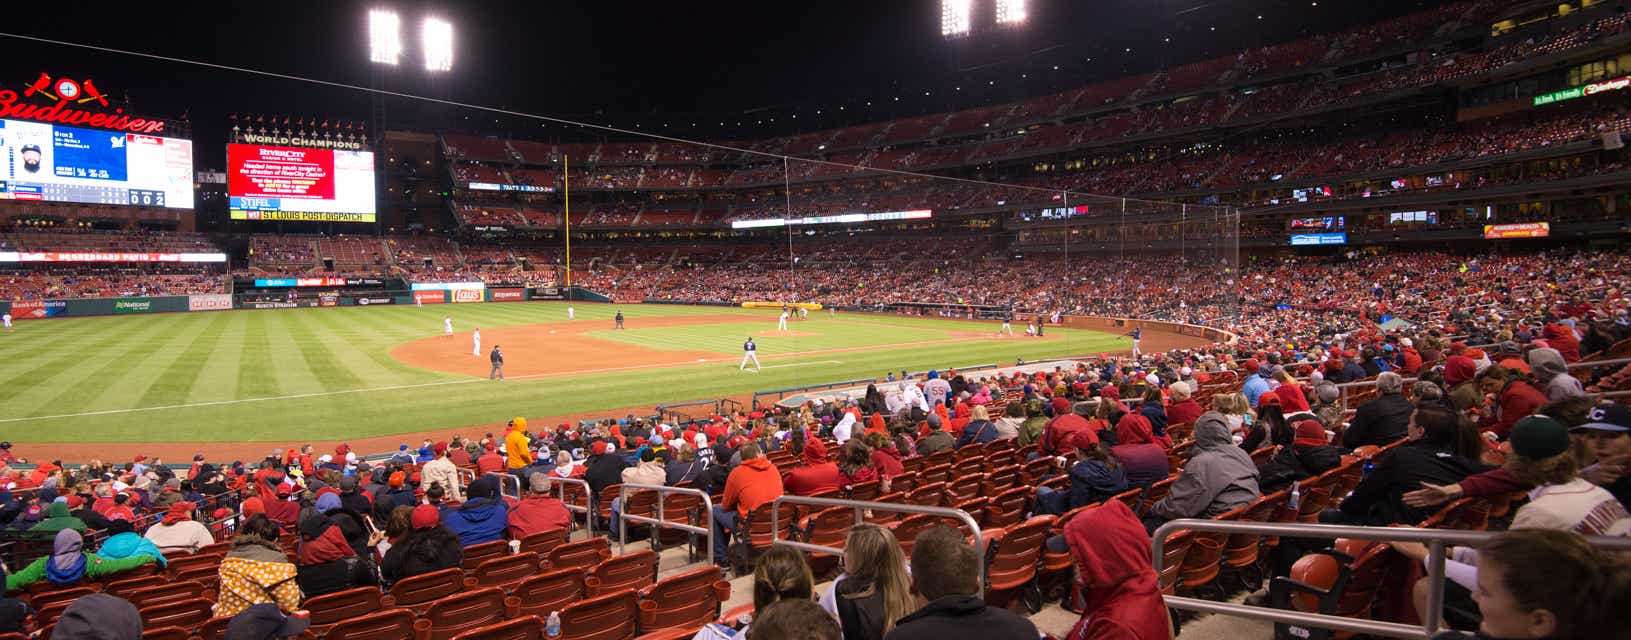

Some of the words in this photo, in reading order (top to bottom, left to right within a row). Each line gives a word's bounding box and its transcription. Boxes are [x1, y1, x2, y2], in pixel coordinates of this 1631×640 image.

[0, 90, 164, 132] Budweiser
[244, 133, 288, 145] WORLD
[291, 137, 360, 150] CHAMPIONS
[131, 195, 139, 205] 0
[143, 195, 151, 205] 0
[156, 196, 164, 206] 2
[276, 211, 300, 220] LOUIS
[38, 300, 66, 308] America
